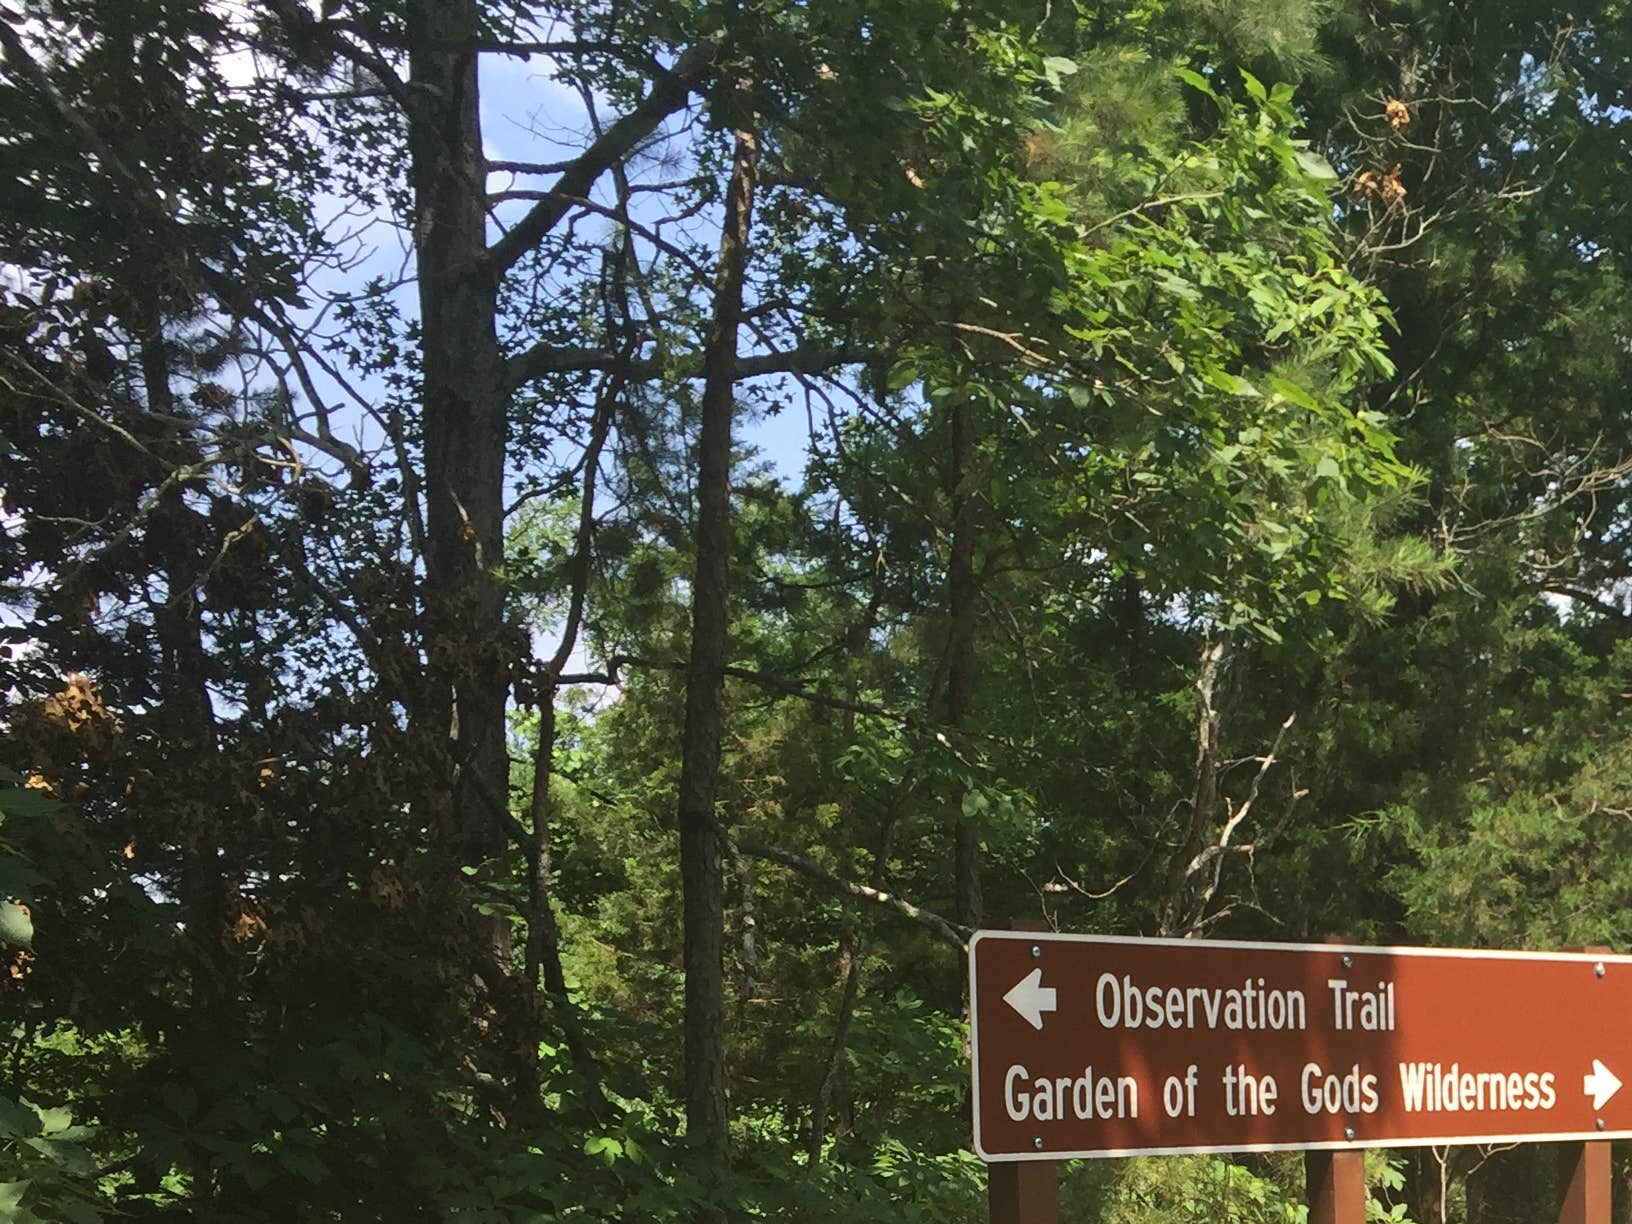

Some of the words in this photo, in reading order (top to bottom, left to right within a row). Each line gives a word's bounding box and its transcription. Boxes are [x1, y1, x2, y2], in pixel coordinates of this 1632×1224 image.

[1096, 973, 1306, 1031] Observation
[1328, 979, 1396, 1031] Trail
[1005, 1064, 1138, 1122] Garden
[1163, 1065, 1198, 1118] of
[1223, 1063, 1277, 1117] the
[1301, 1062, 1379, 1116] Gods
[1399, 1062, 1556, 1113] Wilderness
